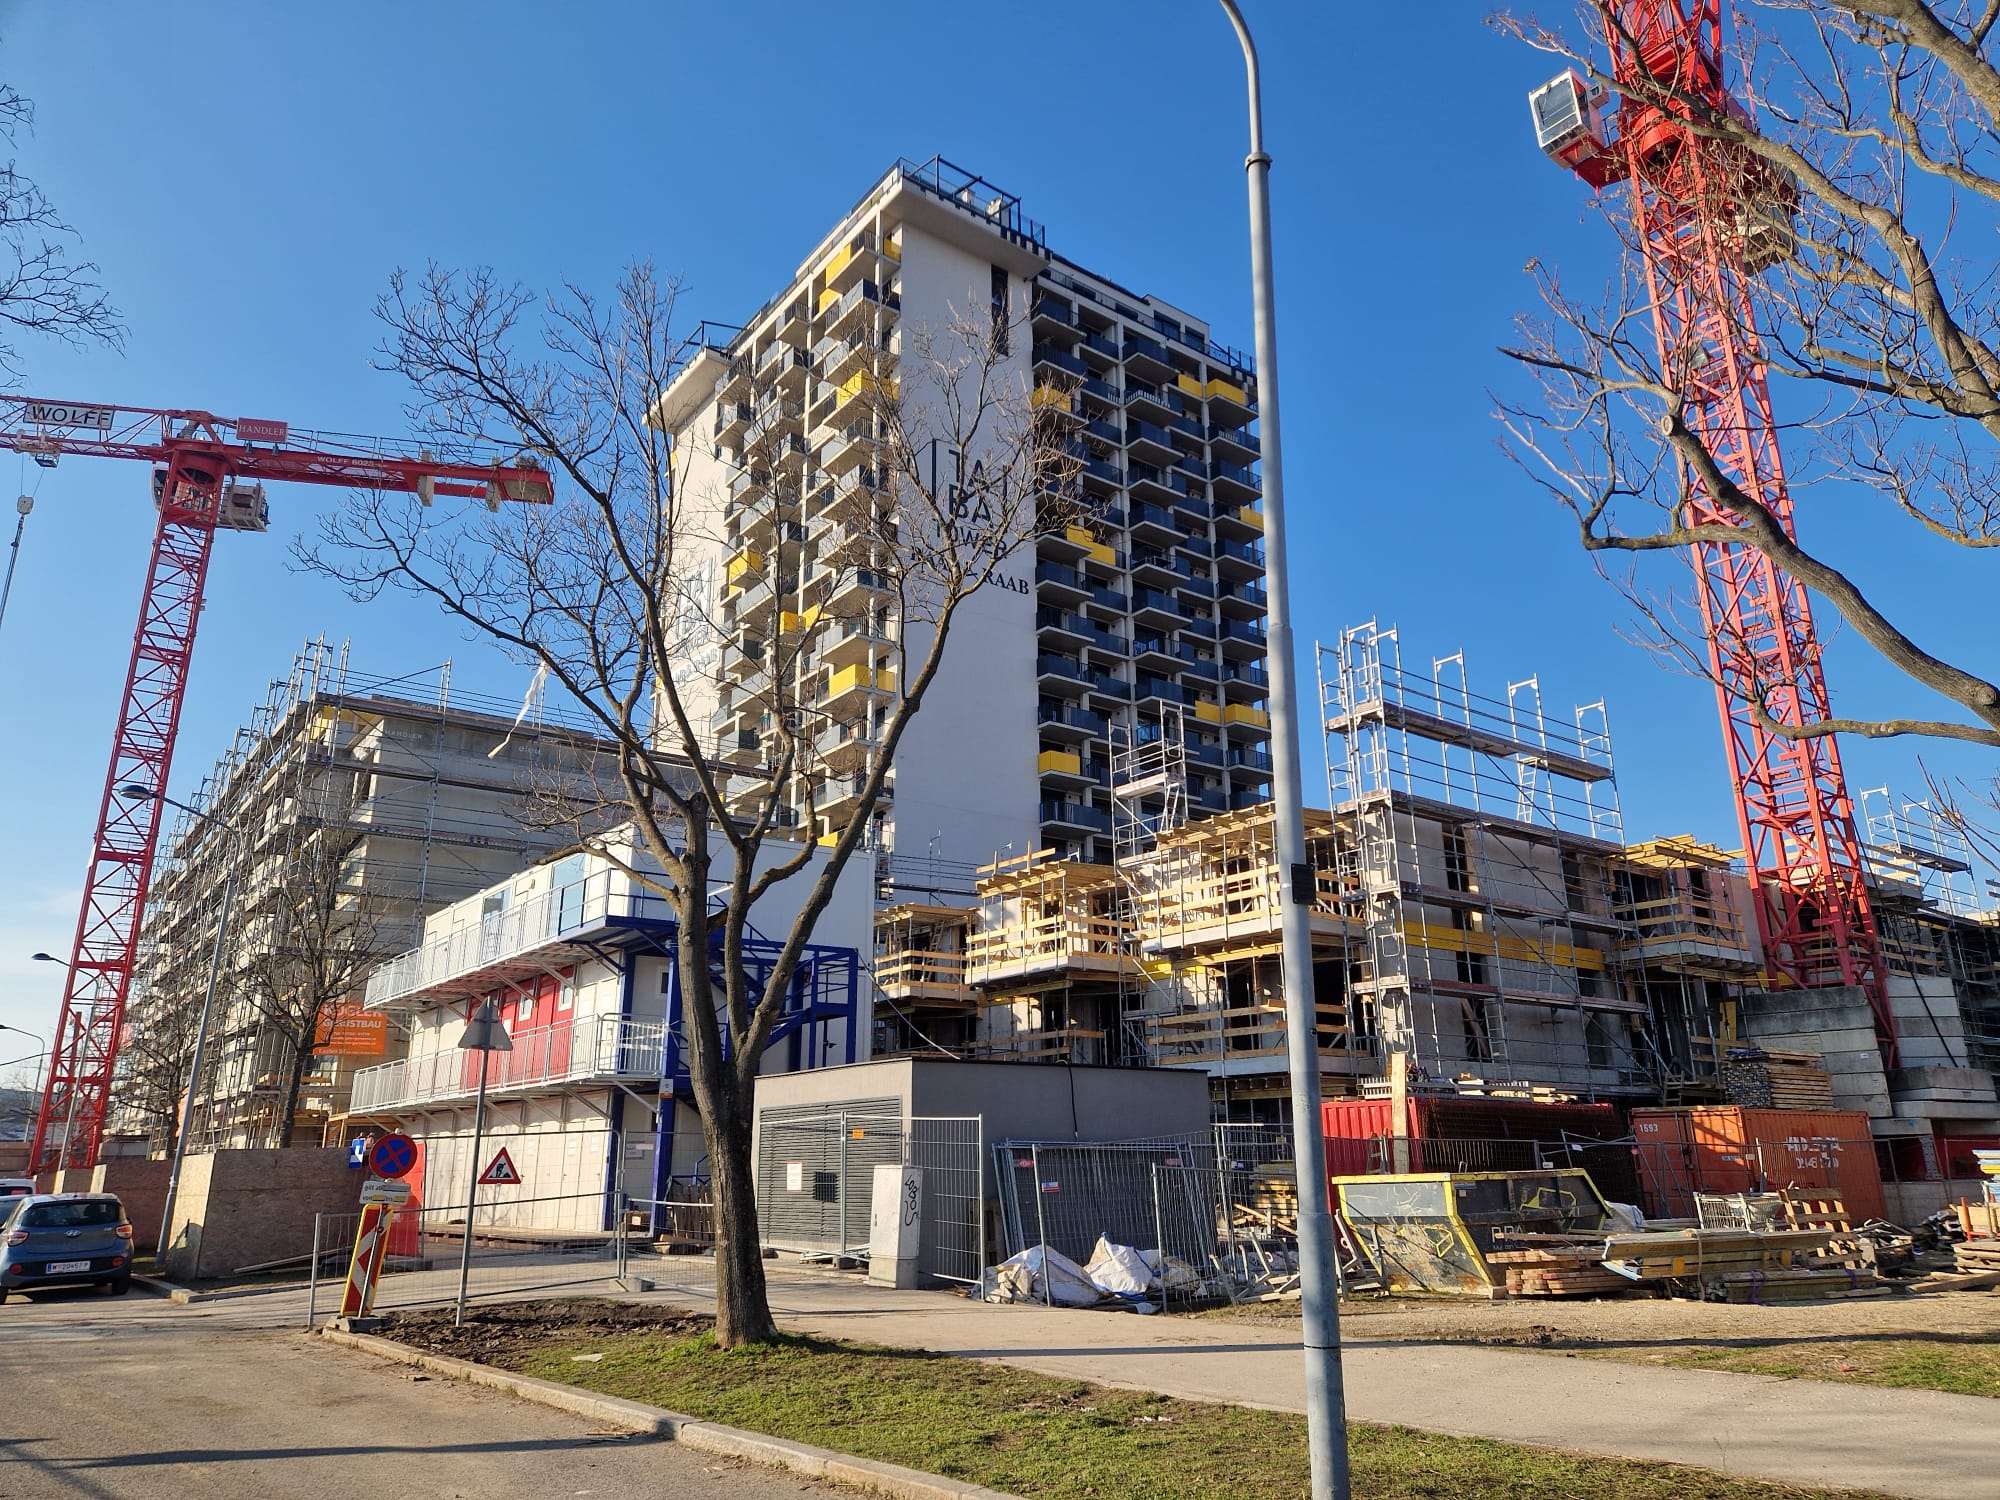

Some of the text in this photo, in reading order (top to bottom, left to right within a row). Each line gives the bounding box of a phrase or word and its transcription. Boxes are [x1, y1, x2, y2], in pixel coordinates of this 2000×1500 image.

[32, 405, 111, 426] WOLFF
[238, 424, 286, 437] HANDLER
[317, 455, 349, 465] WOLFF
[982, 568, 1030, 595] RAAB
[1639, 1123, 1659, 1133] 1593
